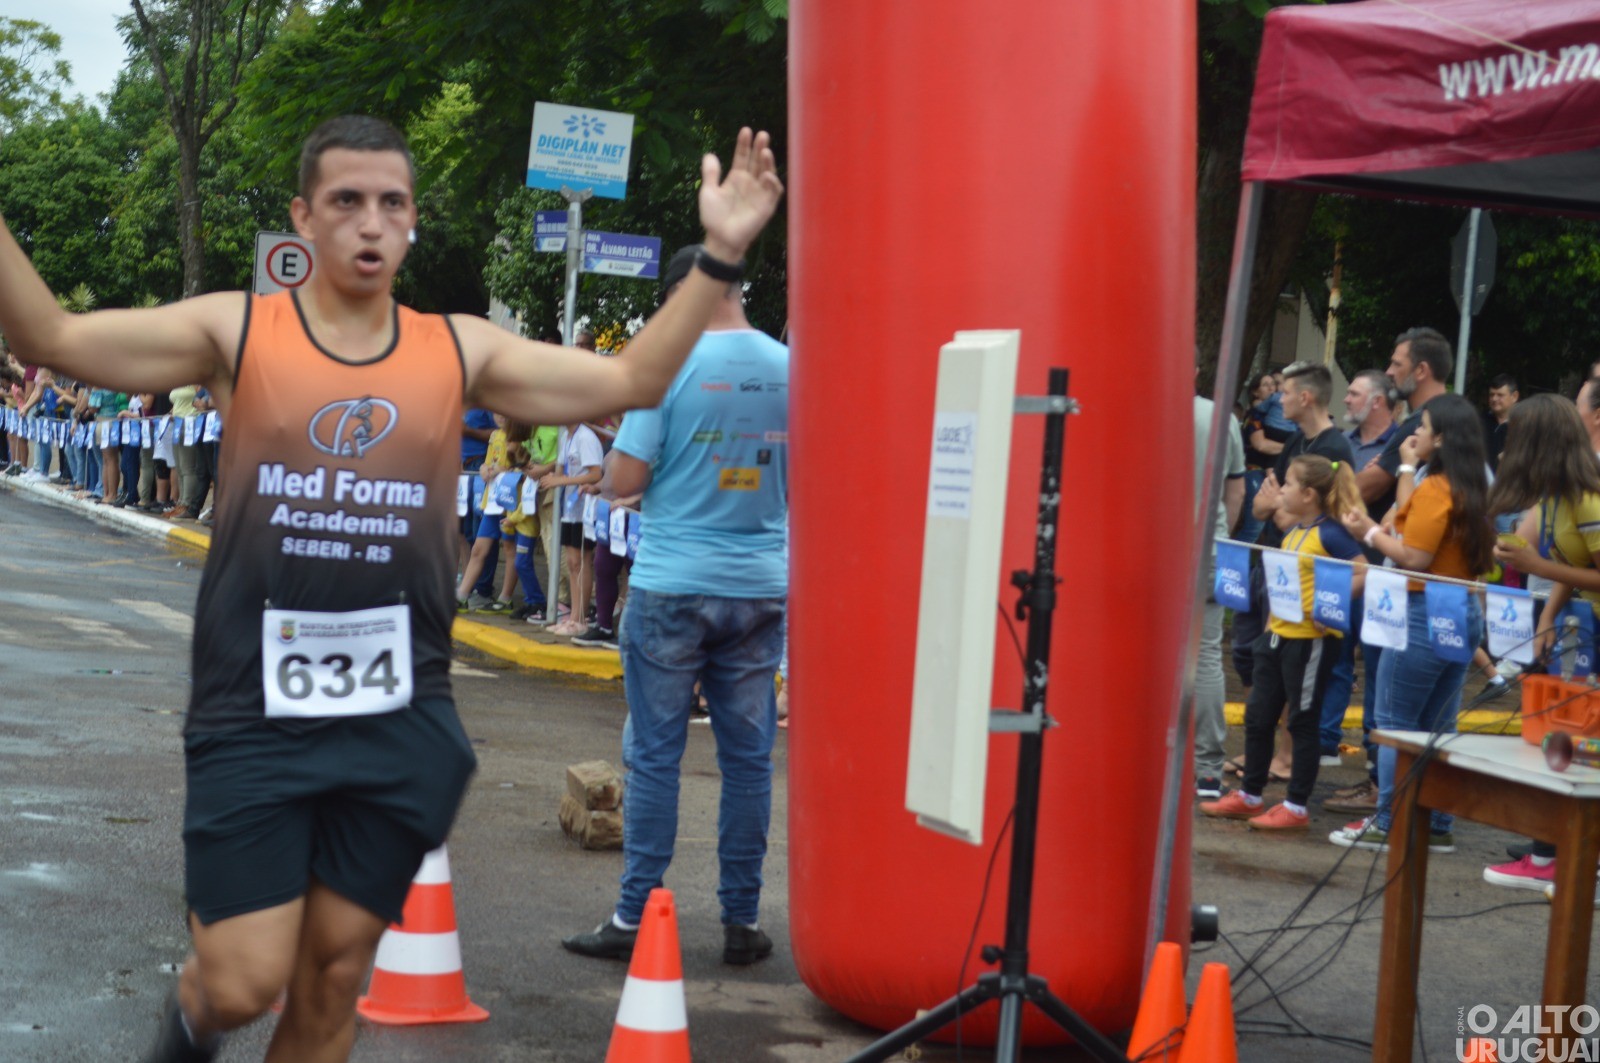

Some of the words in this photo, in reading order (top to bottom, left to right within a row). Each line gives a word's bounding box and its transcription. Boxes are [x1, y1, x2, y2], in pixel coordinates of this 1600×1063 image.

[537, 134, 598, 154] DIGIPLAN
[602, 144, 626, 158] NET
[587, 233, 601, 241] RUA
[586, 243, 599, 254] DR.
[600, 241, 626, 256] ÁLVARO
[628, 246, 653, 259] LEITÃO
[282, 253, 297, 276] E
[257, 463, 326, 500] Med
[334, 469, 427, 508] Forma
[270, 503, 409, 537] Academia
[281, 536, 351, 560] SEBERI
[365, 544, 392, 563] RS
[1221, 567, 1242, 582] AGRO
[1268, 586, 1300, 602] Banrisul
[1317, 590, 1340, 605] AGRO
[1368, 609, 1406, 629] Banrisul
[1431, 616, 1455, 631] AGRO
[1489, 621, 1532, 640] Banrisul
[277, 648, 400, 700] 634
